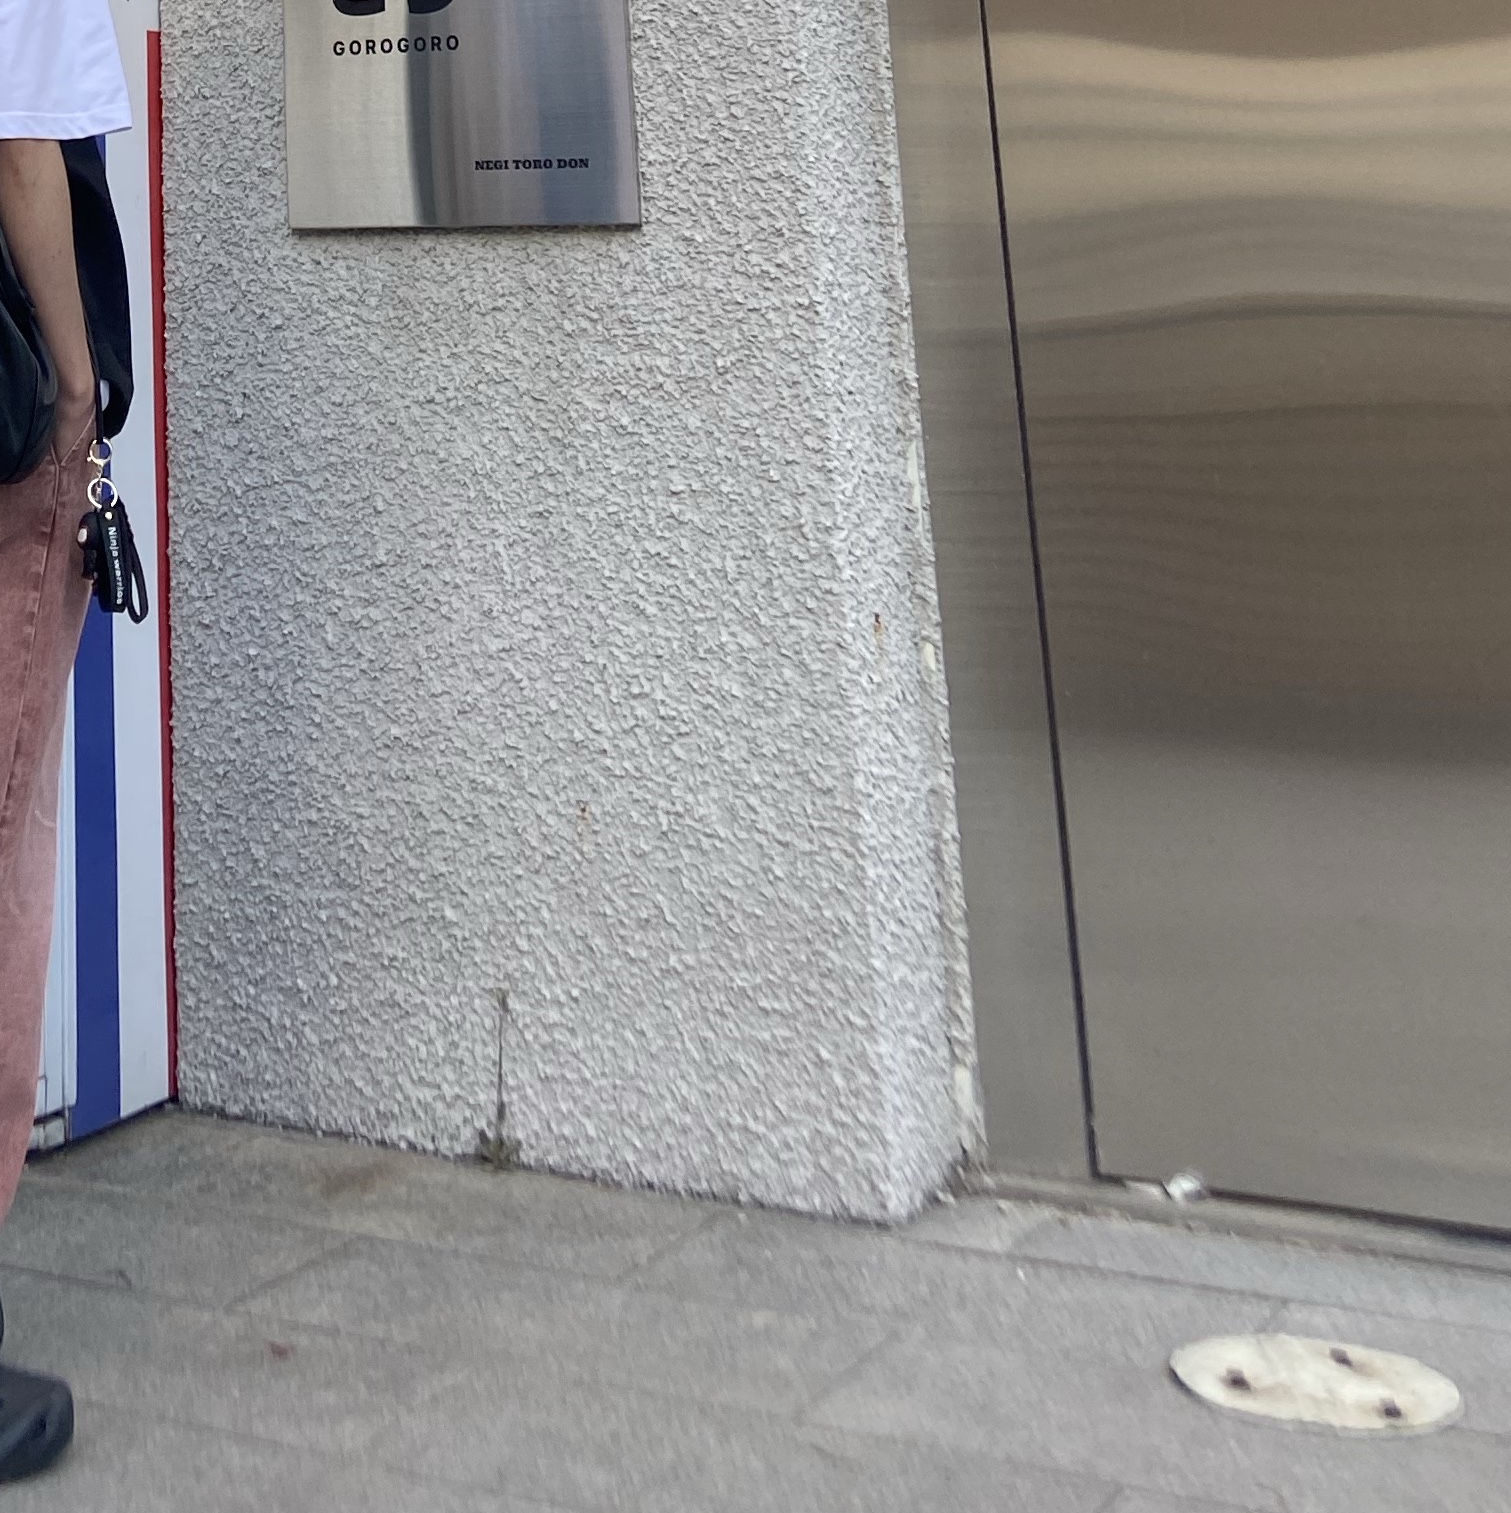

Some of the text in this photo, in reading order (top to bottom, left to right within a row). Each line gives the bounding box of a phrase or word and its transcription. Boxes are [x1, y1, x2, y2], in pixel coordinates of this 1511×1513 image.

[333, 35, 459, 56] GOROGORO
[475, 157, 589, 170] NEGI TORO DON
